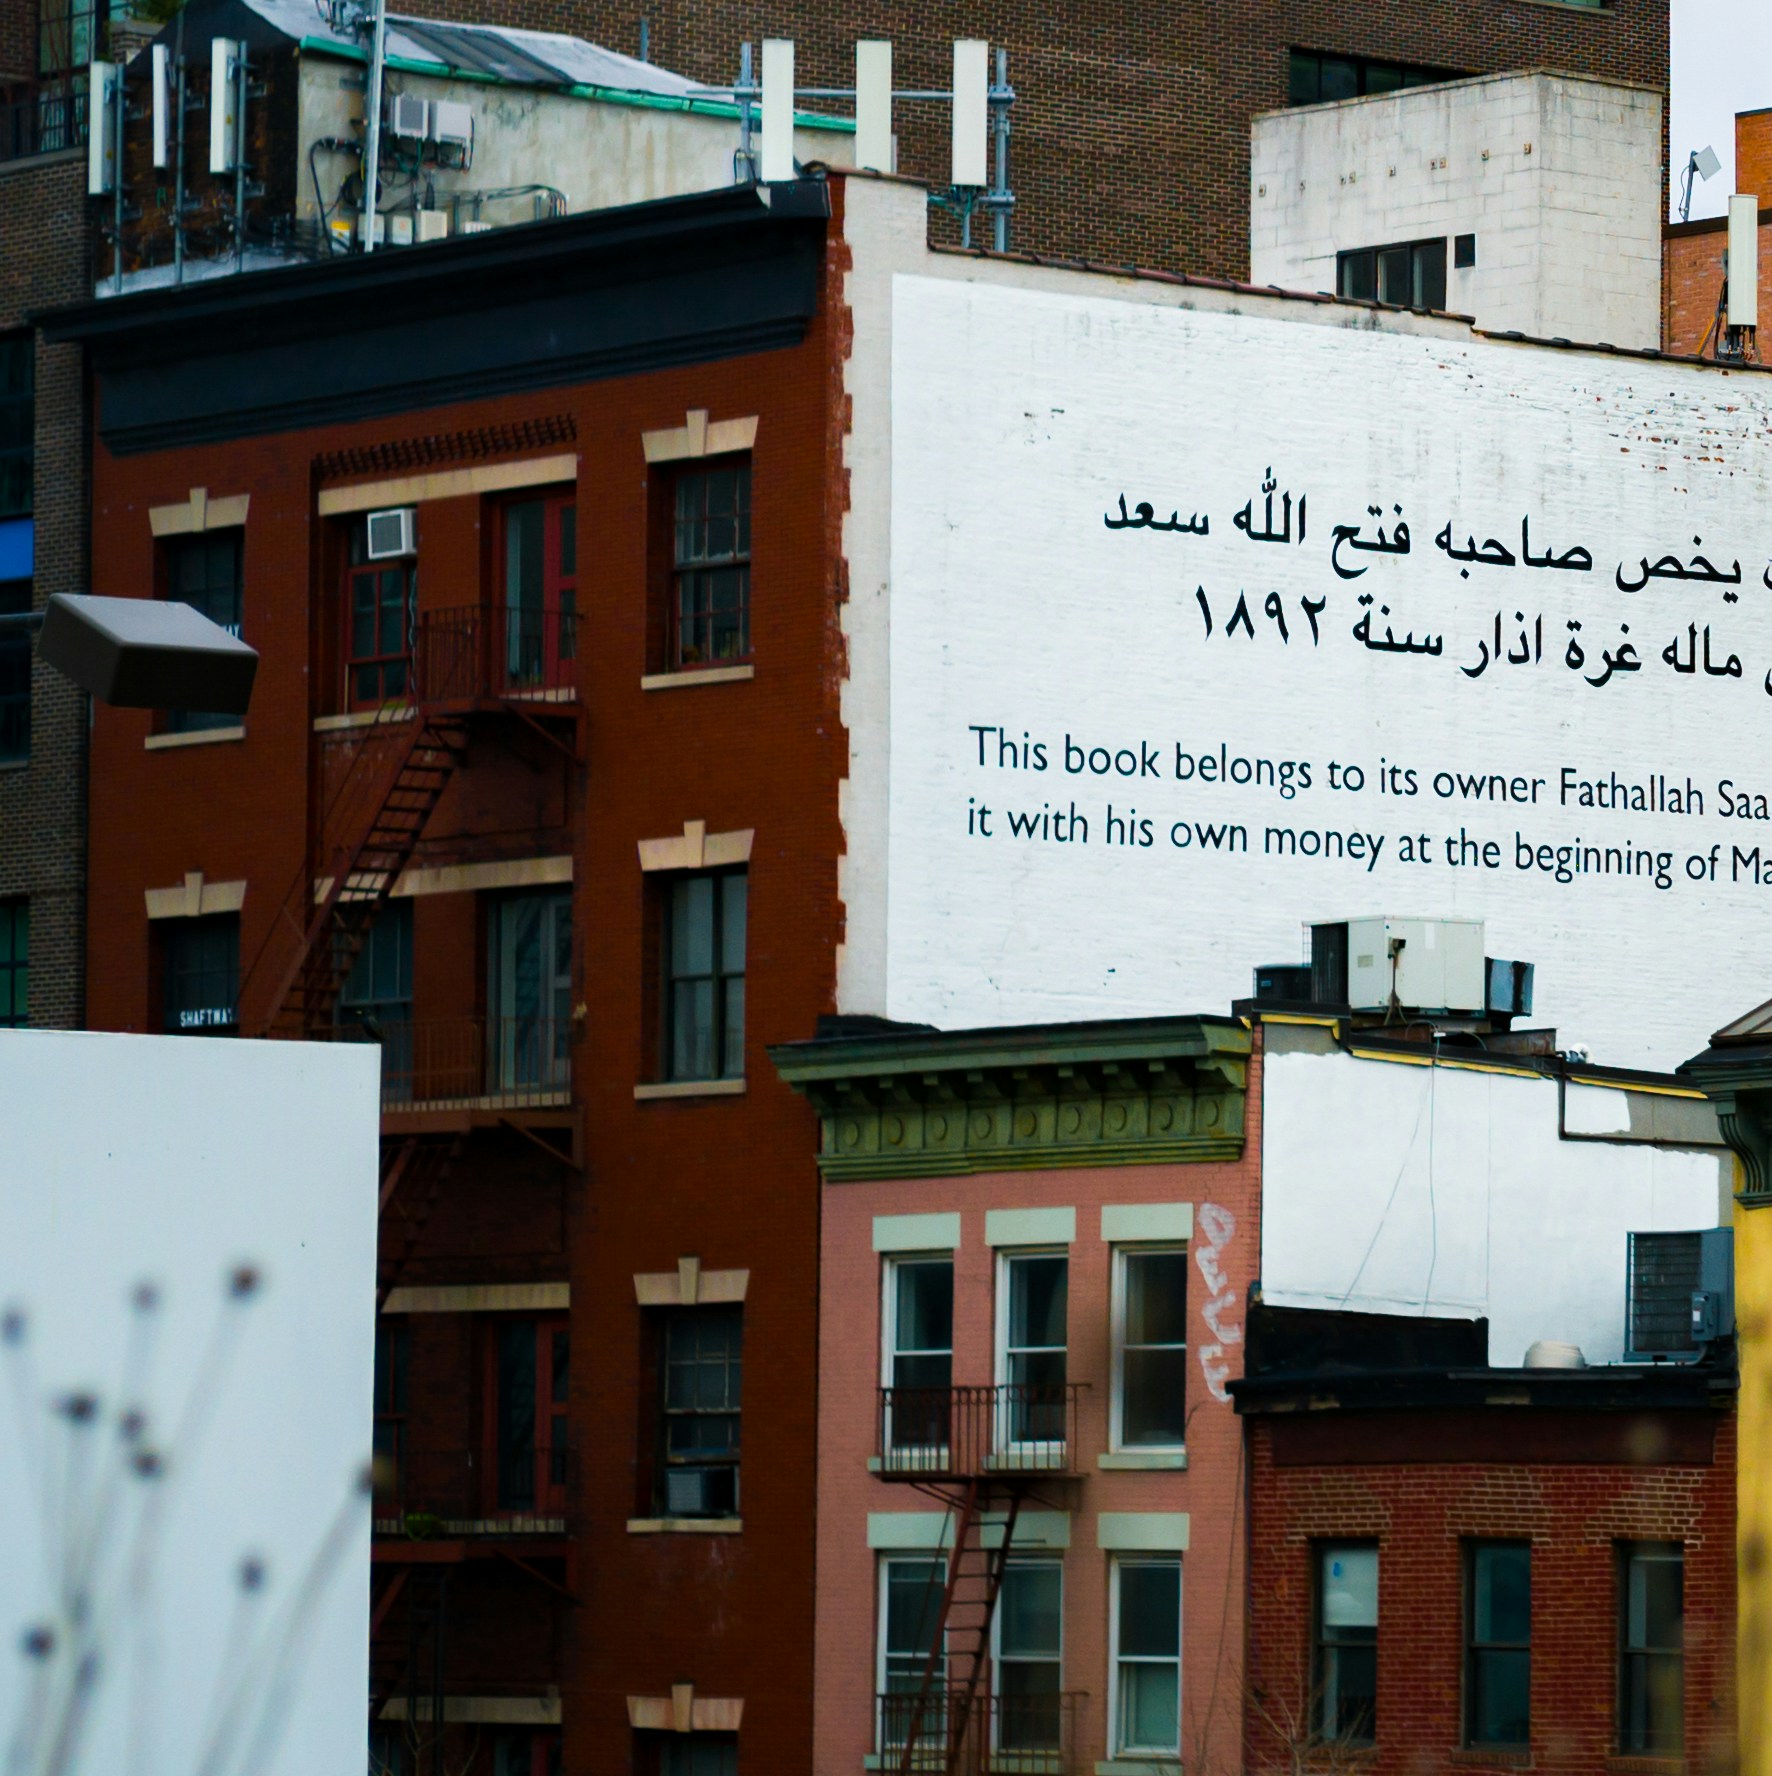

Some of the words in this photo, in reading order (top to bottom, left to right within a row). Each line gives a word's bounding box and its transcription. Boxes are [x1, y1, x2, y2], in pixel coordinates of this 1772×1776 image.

[1104, 492, 1210, 536] سعد
[1331, 503, 1411, 580] فتح
[1434, 514, 1593, 580] صاحبه
[1615, 535, 1742, 604] يخص
[1195, 585, 1327, 647] ١٨٩٢
[1352, 593, 1443, 657] سنة
[1460, 610, 1542, 679] اذار
[1661, 621, 1743, 679] ماله
[1564, 619, 1642, 688] غرة
[968, 725, 1048, 772] This
[1064, 733, 1161, 778] book
[1175, 742, 1313, 800] belongs
[1327, 760, 1365, 792] to
[1380, 757, 1419, 796] its
[1432, 772, 1546, 804] owner
[1560, 767, 1704, 816] Fathallah
[968, 797, 993, 837] it
[1007, 801, 1088, 844] with
[1106, 804, 1154, 848] his
[1170, 822, 1248, 852] own
[1264, 827, 1385, 873] money
[1398, 833, 1432, 864] at
[1444, 827, 1501, 869] the
[1515, 831, 1673, 890] beginning
[1685, 844, 1721, 882] of
